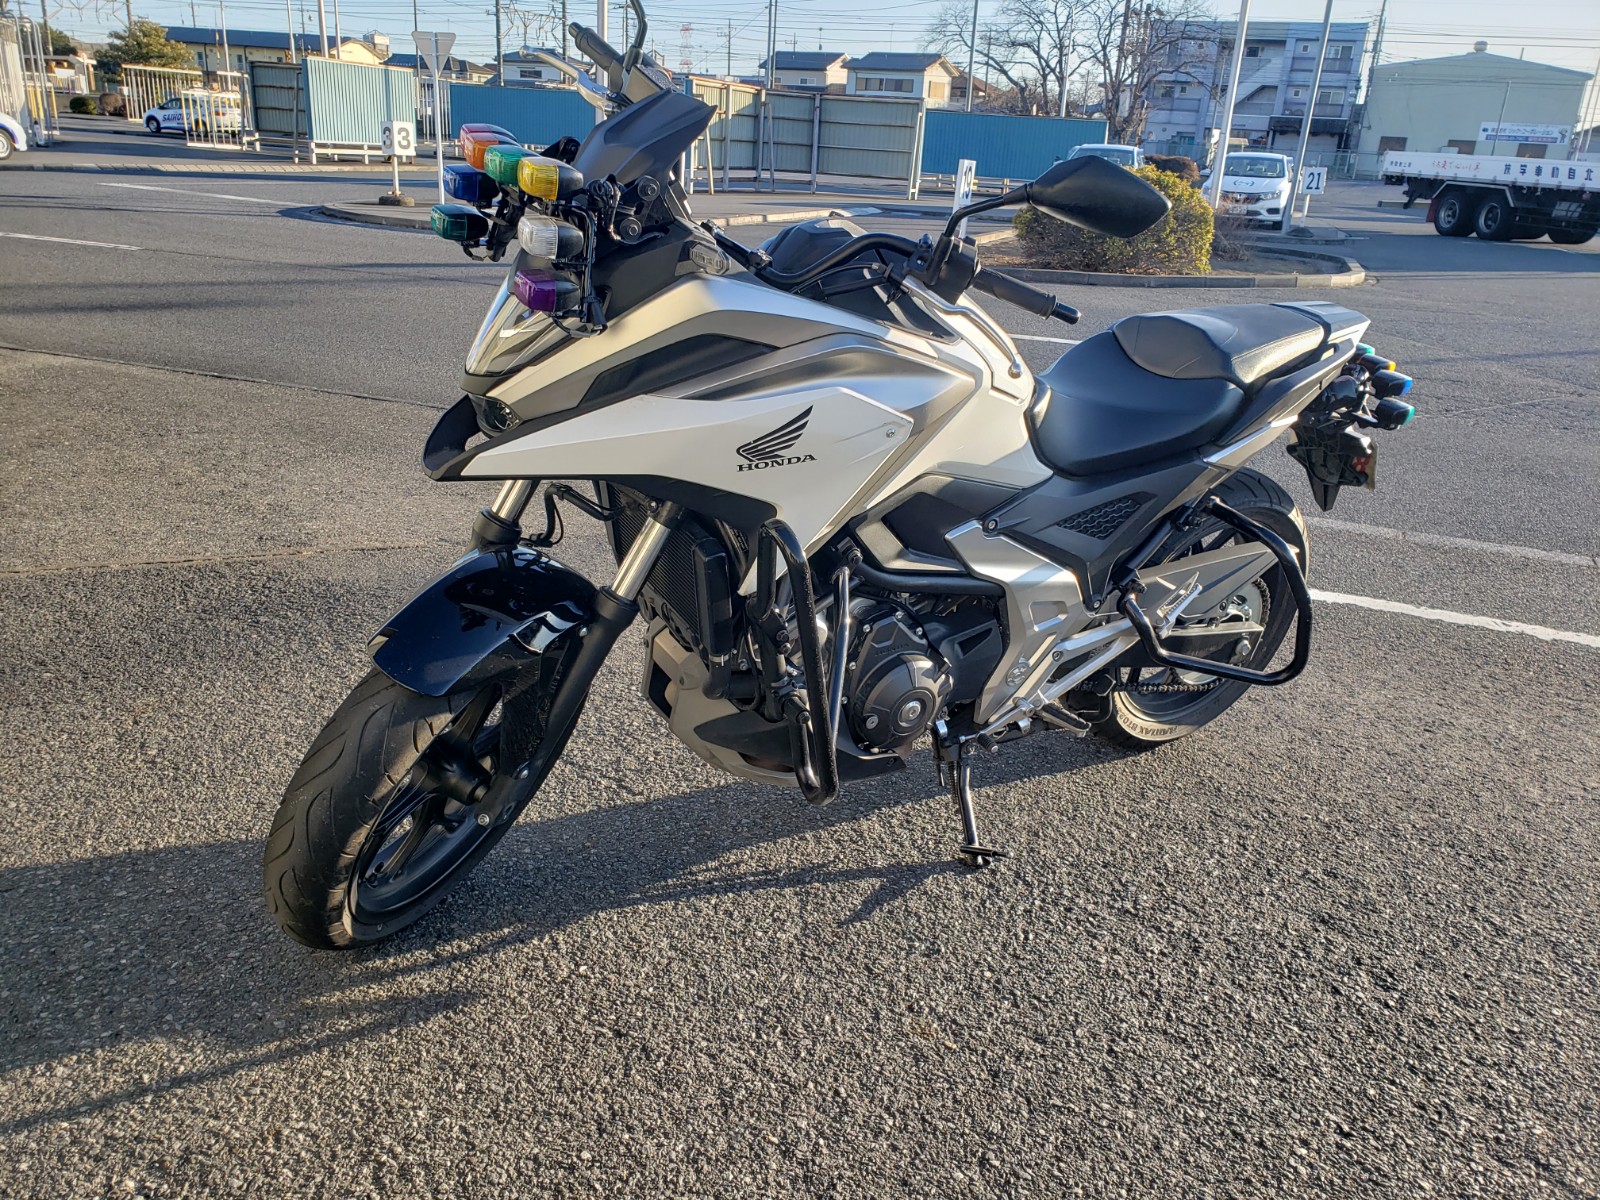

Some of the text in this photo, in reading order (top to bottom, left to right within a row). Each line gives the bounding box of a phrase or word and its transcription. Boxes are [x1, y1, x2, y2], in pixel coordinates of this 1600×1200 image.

[383, 126, 392, 149] 3
[397, 127, 411, 149] 3
[962, 166, 972, 199] 19
[1306, 172, 1322, 190] 21
[736, 454, 818, 472] HONDA
